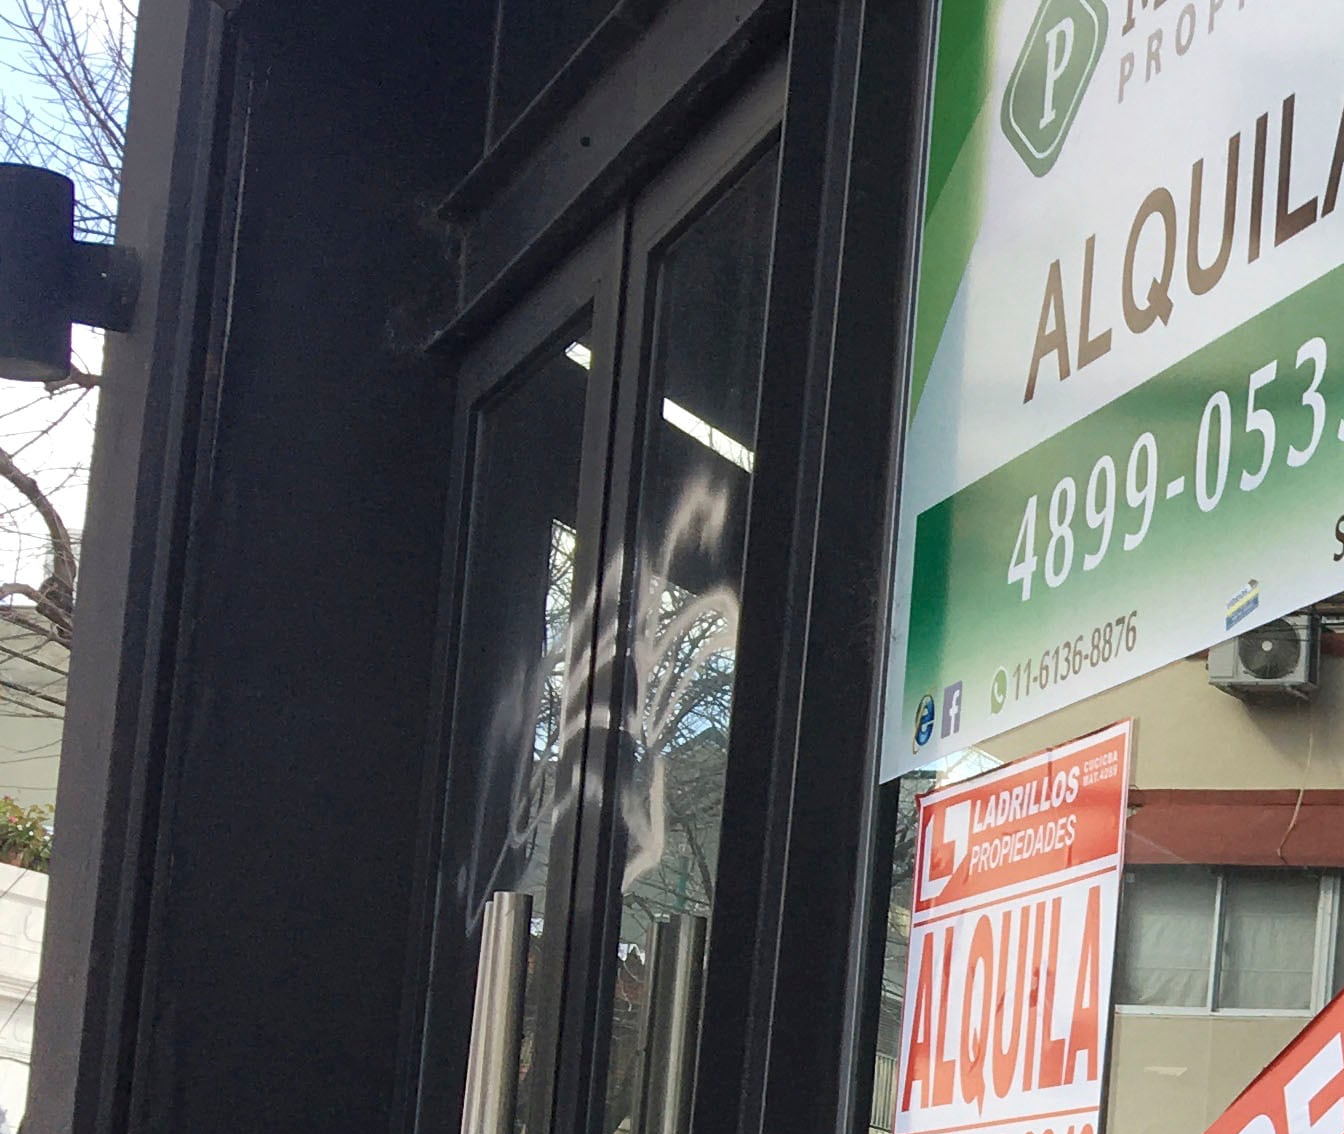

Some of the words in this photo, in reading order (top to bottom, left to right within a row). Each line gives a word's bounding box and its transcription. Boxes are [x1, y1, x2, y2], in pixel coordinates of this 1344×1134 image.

[1118, 0, 1246, 104] PROP
[1012, 611, 1138, 700] 11-6136-8876
[973, 766, 1080, 833] LADRILLOS
[969, 814, 1077, 876] PROPIEDADES
[901, 886, 1100, 1117] ALQUILA
